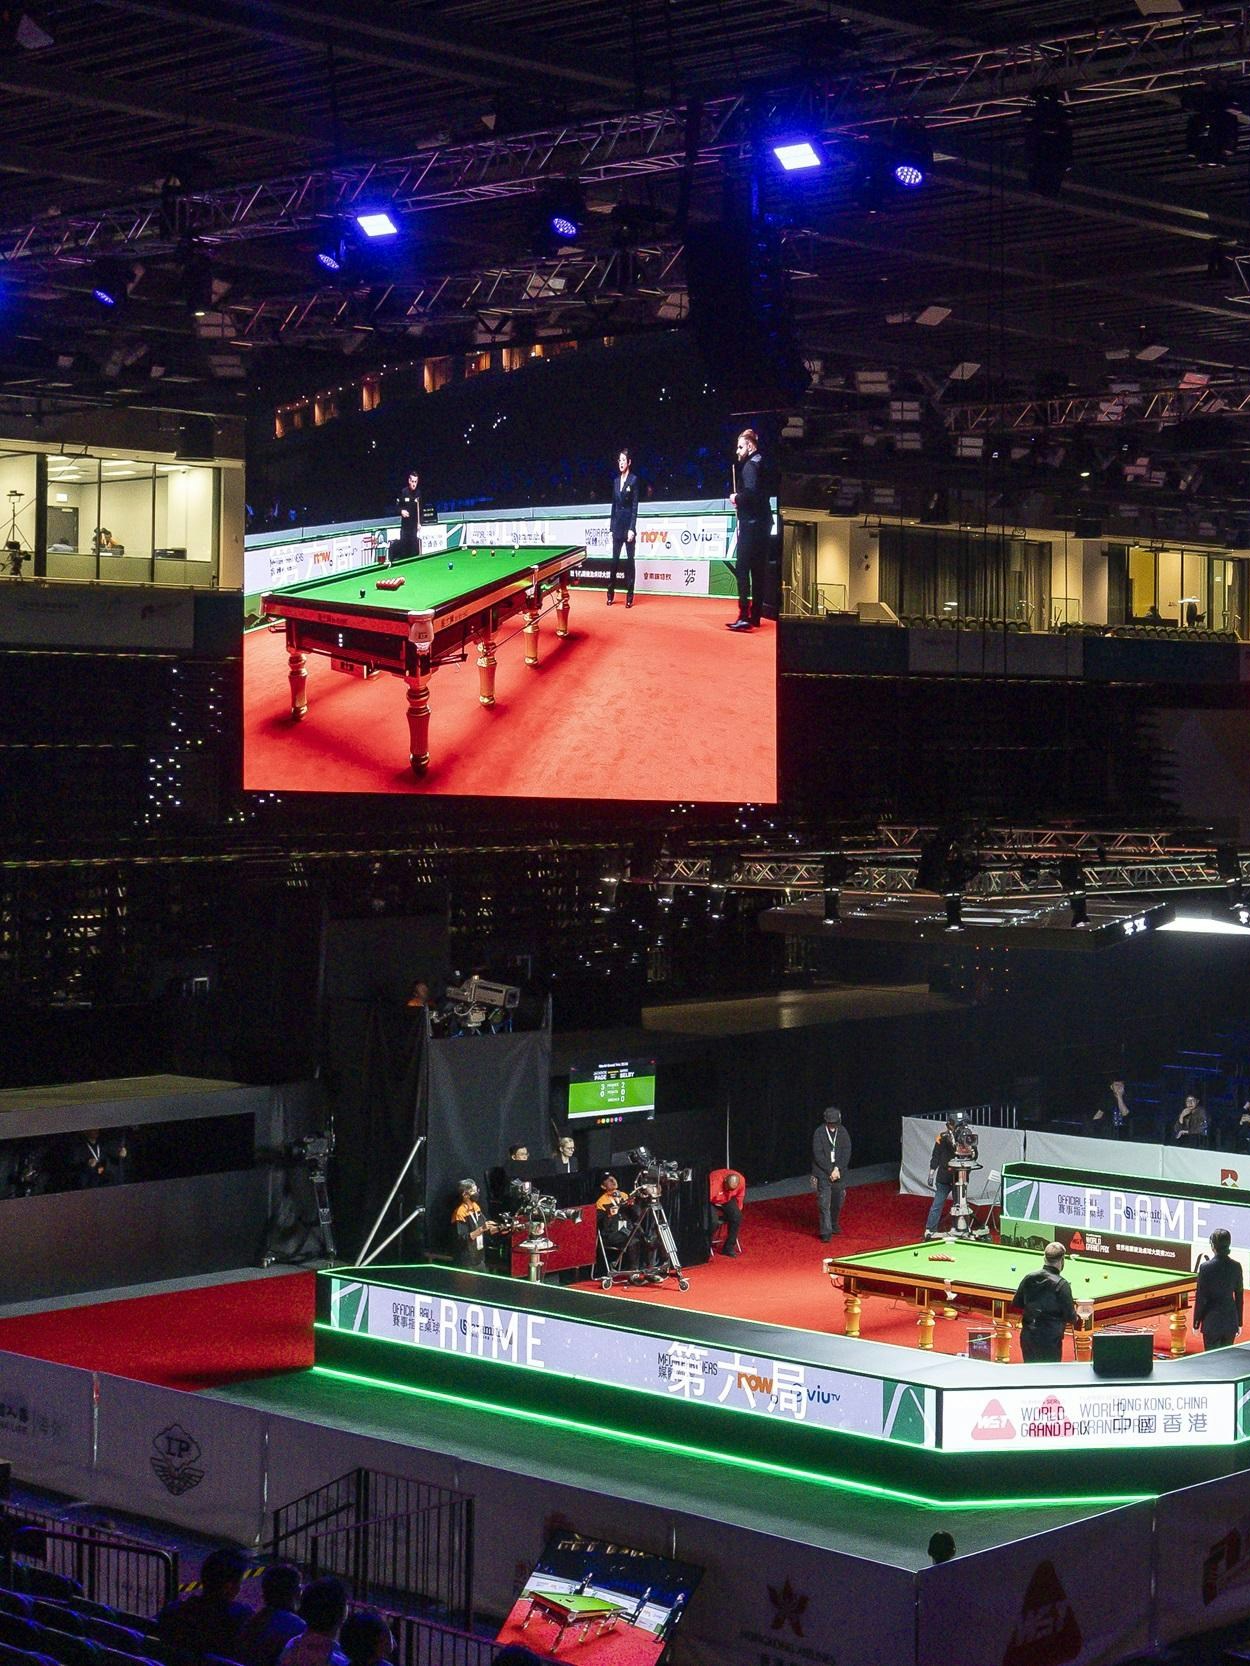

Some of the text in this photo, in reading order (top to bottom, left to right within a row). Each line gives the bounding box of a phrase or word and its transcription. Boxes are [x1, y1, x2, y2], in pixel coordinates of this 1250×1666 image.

[1085, 1187, 1212, 1242] FRAME
[414, 1293, 546, 1369] FRAME
[667, 1340, 808, 1420] 第六局
[1020, 1406, 1065, 1422] WORLD
[1176, 1396, 1208, 1410] CHINA
[1020, 1422, 1062, 1438] GRAND
